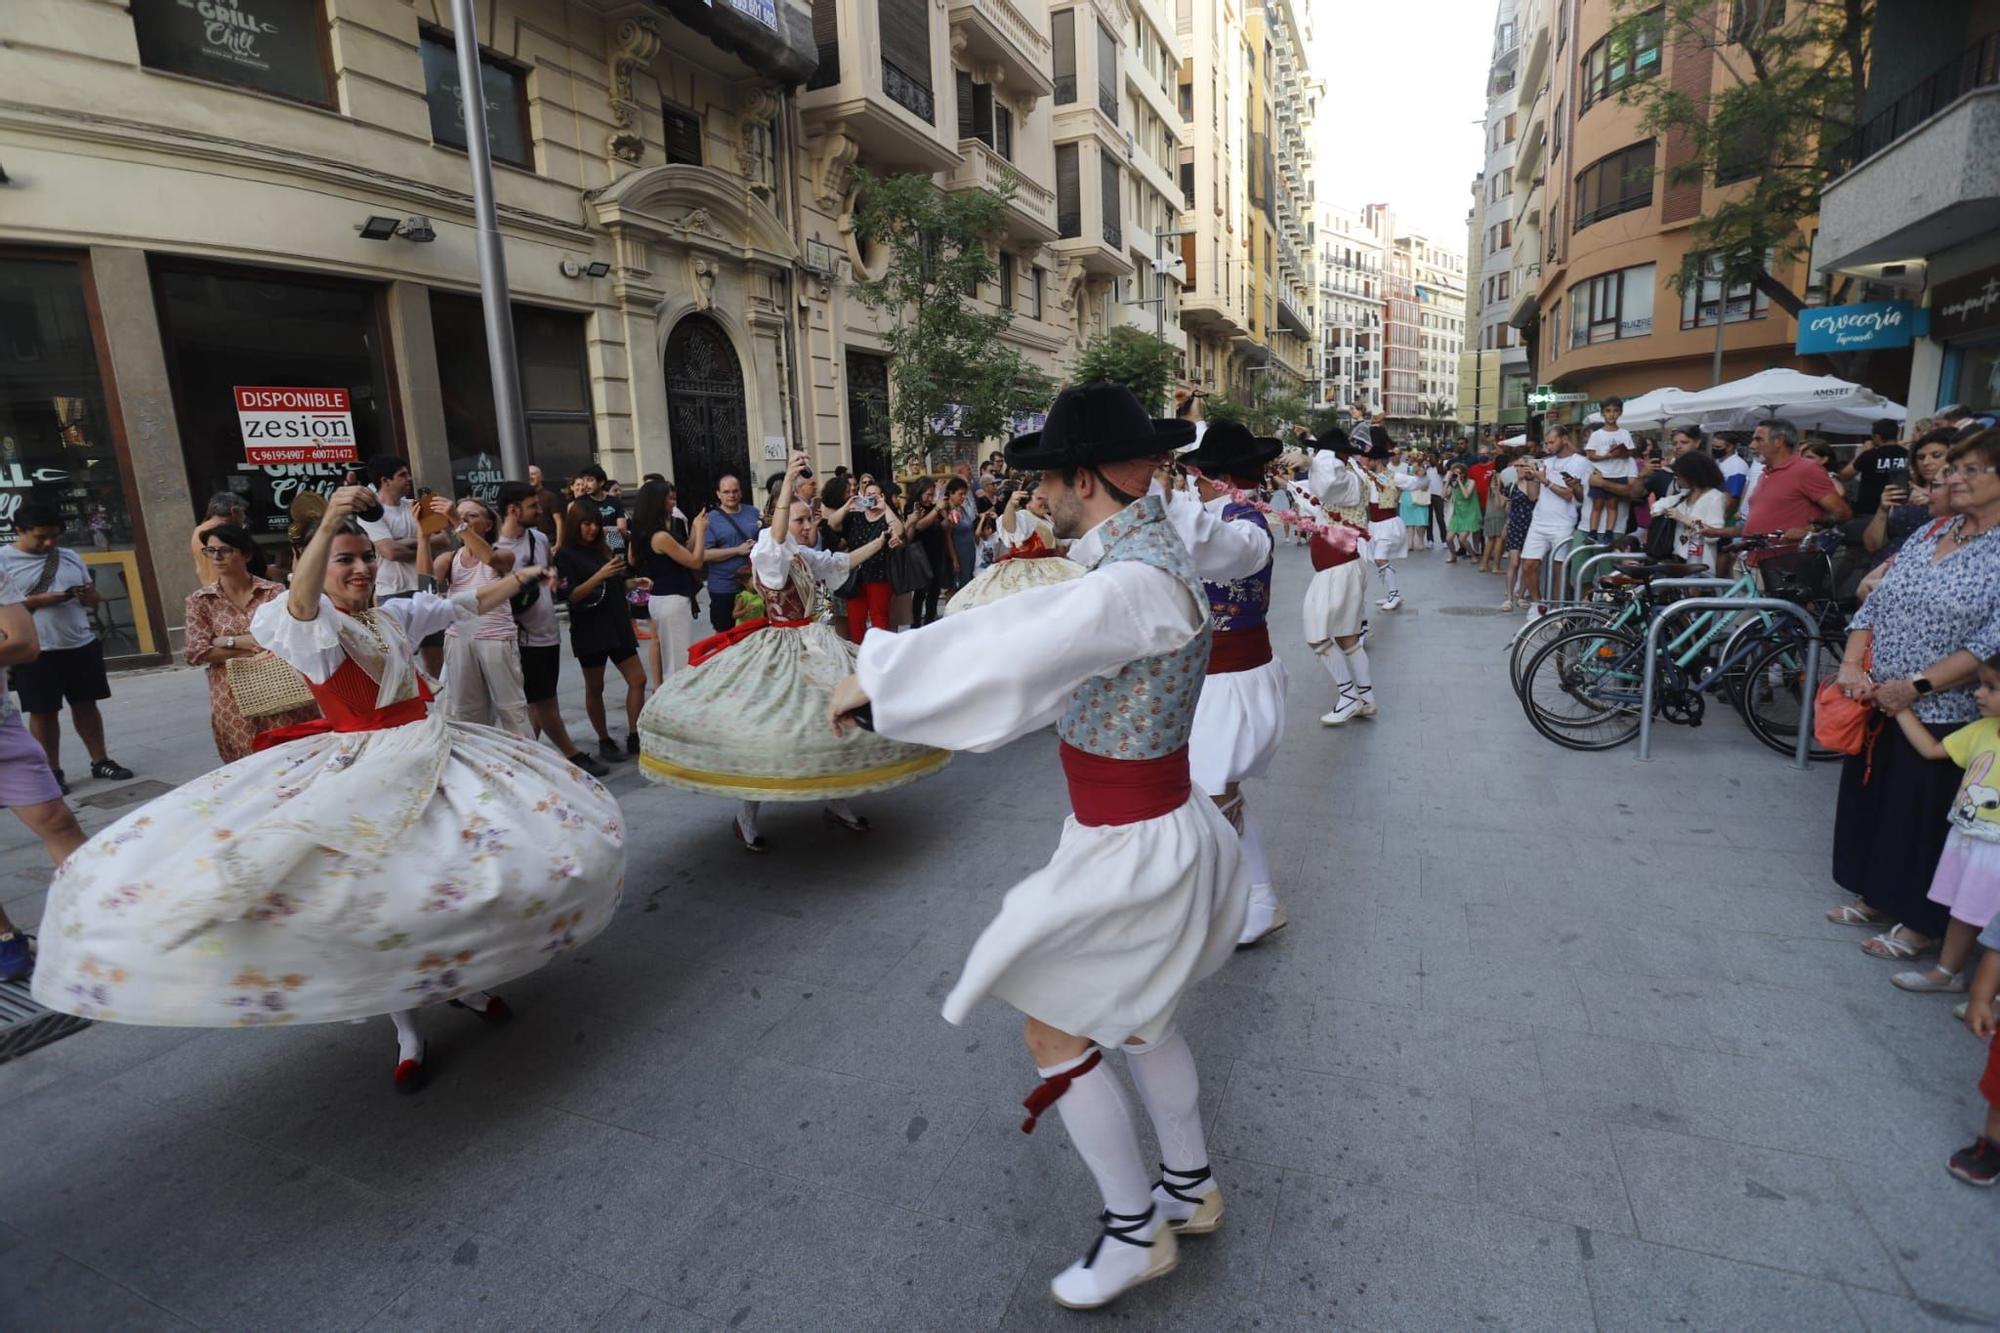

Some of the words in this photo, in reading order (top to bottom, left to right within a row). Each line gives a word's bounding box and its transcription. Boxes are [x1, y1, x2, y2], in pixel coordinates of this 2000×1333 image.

[242, 392, 345, 408] DISPONIBLE
[245, 415, 351, 438] zesion
[312, 449, 353, 459] 600721472
